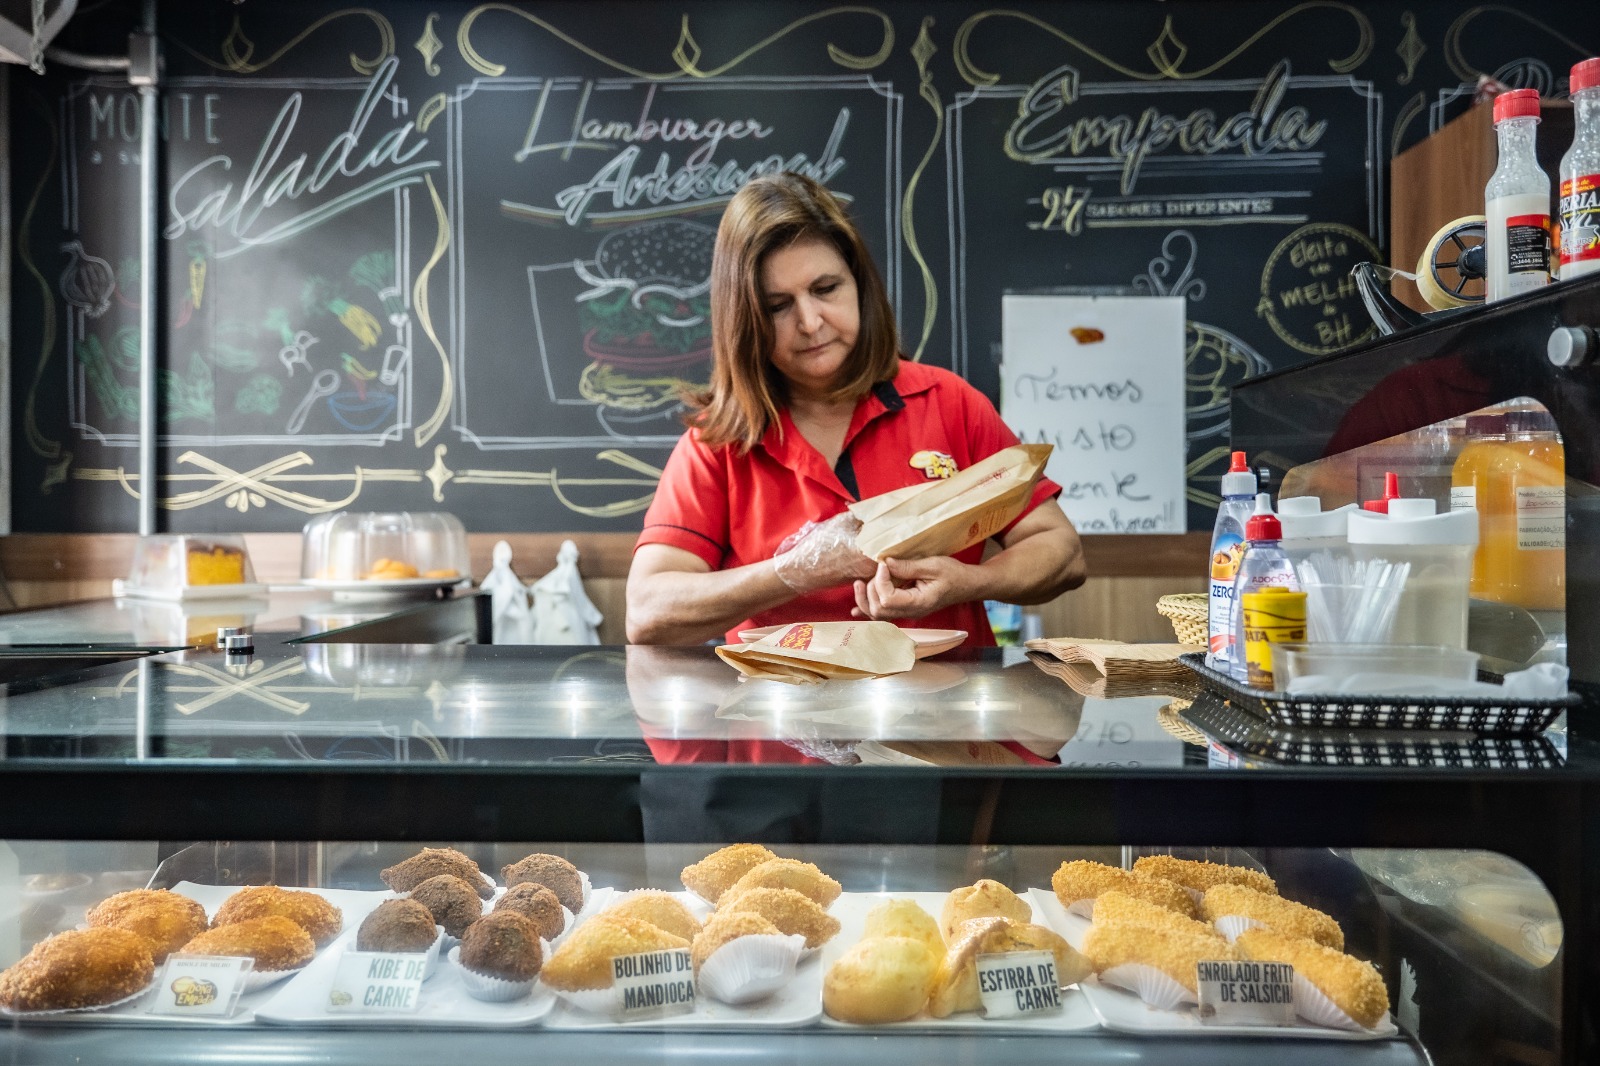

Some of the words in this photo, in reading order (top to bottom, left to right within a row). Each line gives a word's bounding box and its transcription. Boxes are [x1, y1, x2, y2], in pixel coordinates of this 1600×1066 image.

[514, 78, 774, 170] Hamburger
[1004, 58, 1329, 196] Empada
[162, 55, 429, 240] Salada
[1560, 191, 1600, 214] PERIA
[1280, 272, 1356, 309] MELH
[1314, 312, 1352, 345] BH
[368, 958, 403, 979] KIBE
[405, 959, 425, 980] DE
[614, 952, 672, 978] BOLINHO
[676, 951, 692, 971] DE
[979, 965, 1037, 993] ESFIRRA
[1039, 963, 1055, 983] DE
[1197, 962, 1260, 982] ENROLADO
[363, 985, 414, 1008] CARNE
[624, 980, 695, 1010] MANDIOCA
[1016, 985, 1062, 1012] CARNE
[1220, 983, 1237, 1002] DE
